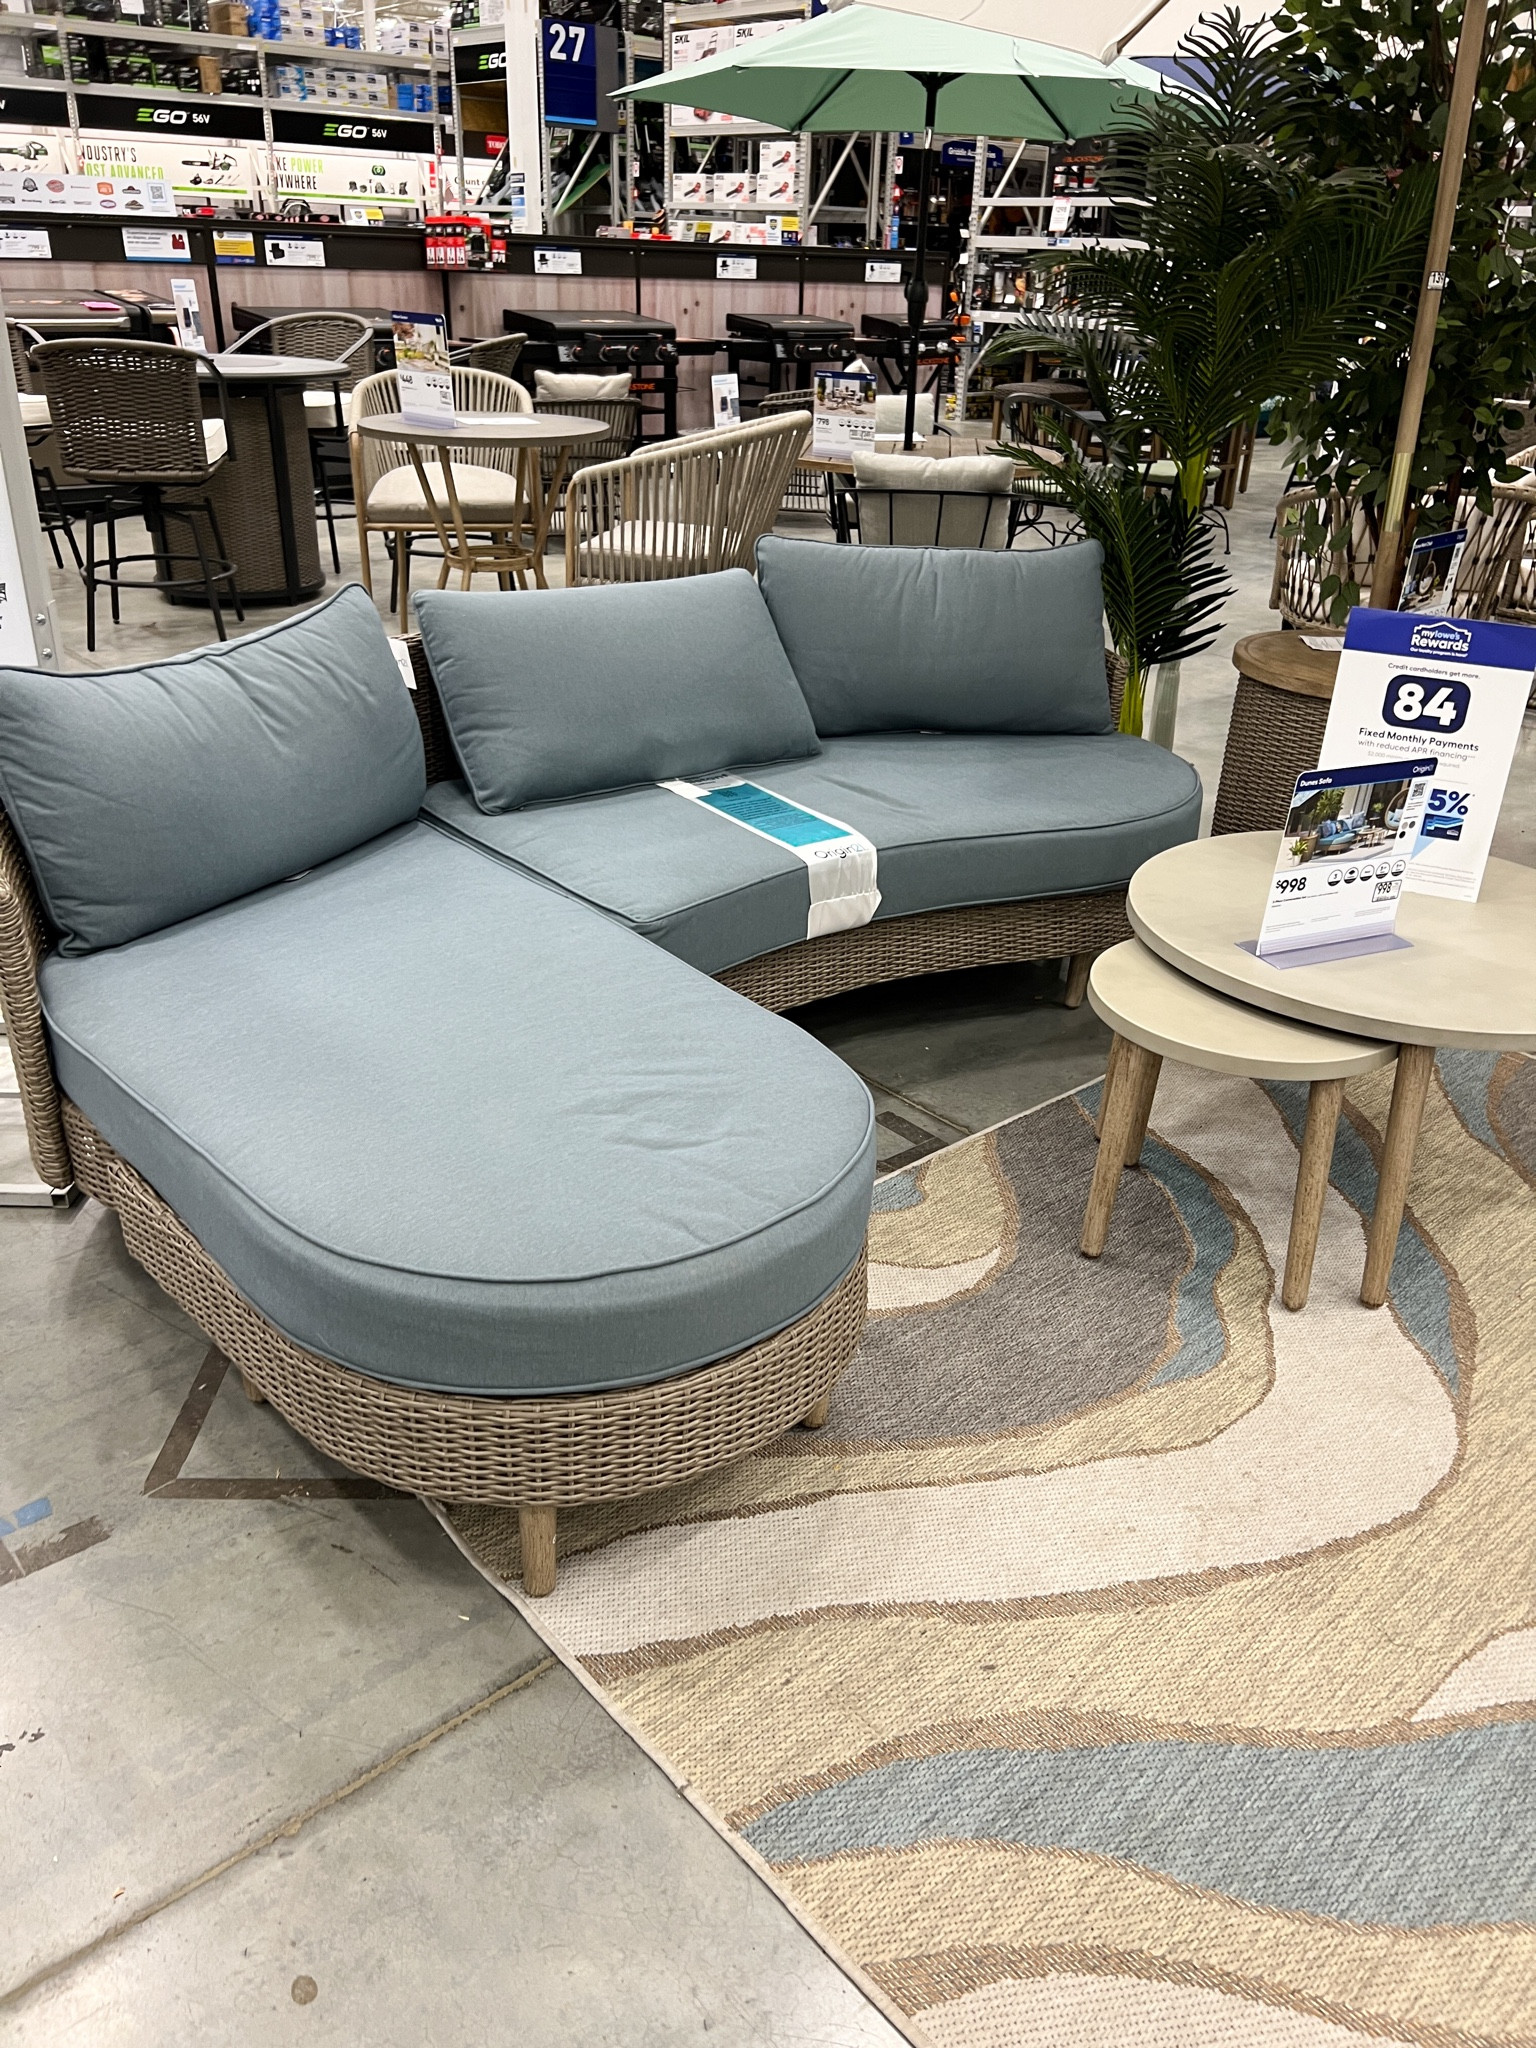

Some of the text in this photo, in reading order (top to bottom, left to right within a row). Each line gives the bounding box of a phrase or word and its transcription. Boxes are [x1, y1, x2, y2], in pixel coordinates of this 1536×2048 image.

[674, 34, 690, 44] SKIL
[736, 28, 754, 38] SKIL
[549, 23, 585, 62] 27
[136, 108, 210, 124] EGO 56V
[322, 123, 387, 139] EGO 56V
[81, 145, 137, 162] NDUSTRY'S
[86, 162, 106, 177] OST
[290, 157, 324, 174] POWER
[1411, 634, 1469, 652] Rewards
[1387, 662, 1408, 671] Credit
[1409, 666, 1448, 676] cardholders
[1449, 670, 1461, 678] get
[1393, 682, 1457, 726] 84
[1358, 740, 1375, 748] with
[1376, 742, 1410, 753] reduced
[1411, 744, 1428, 755] APR
[1359, 727, 1479, 752] Fixed Monthly Payments
[1300, 777, 1333, 787] Dunes Sofa
[1275, 876, 1307, 894] $998
